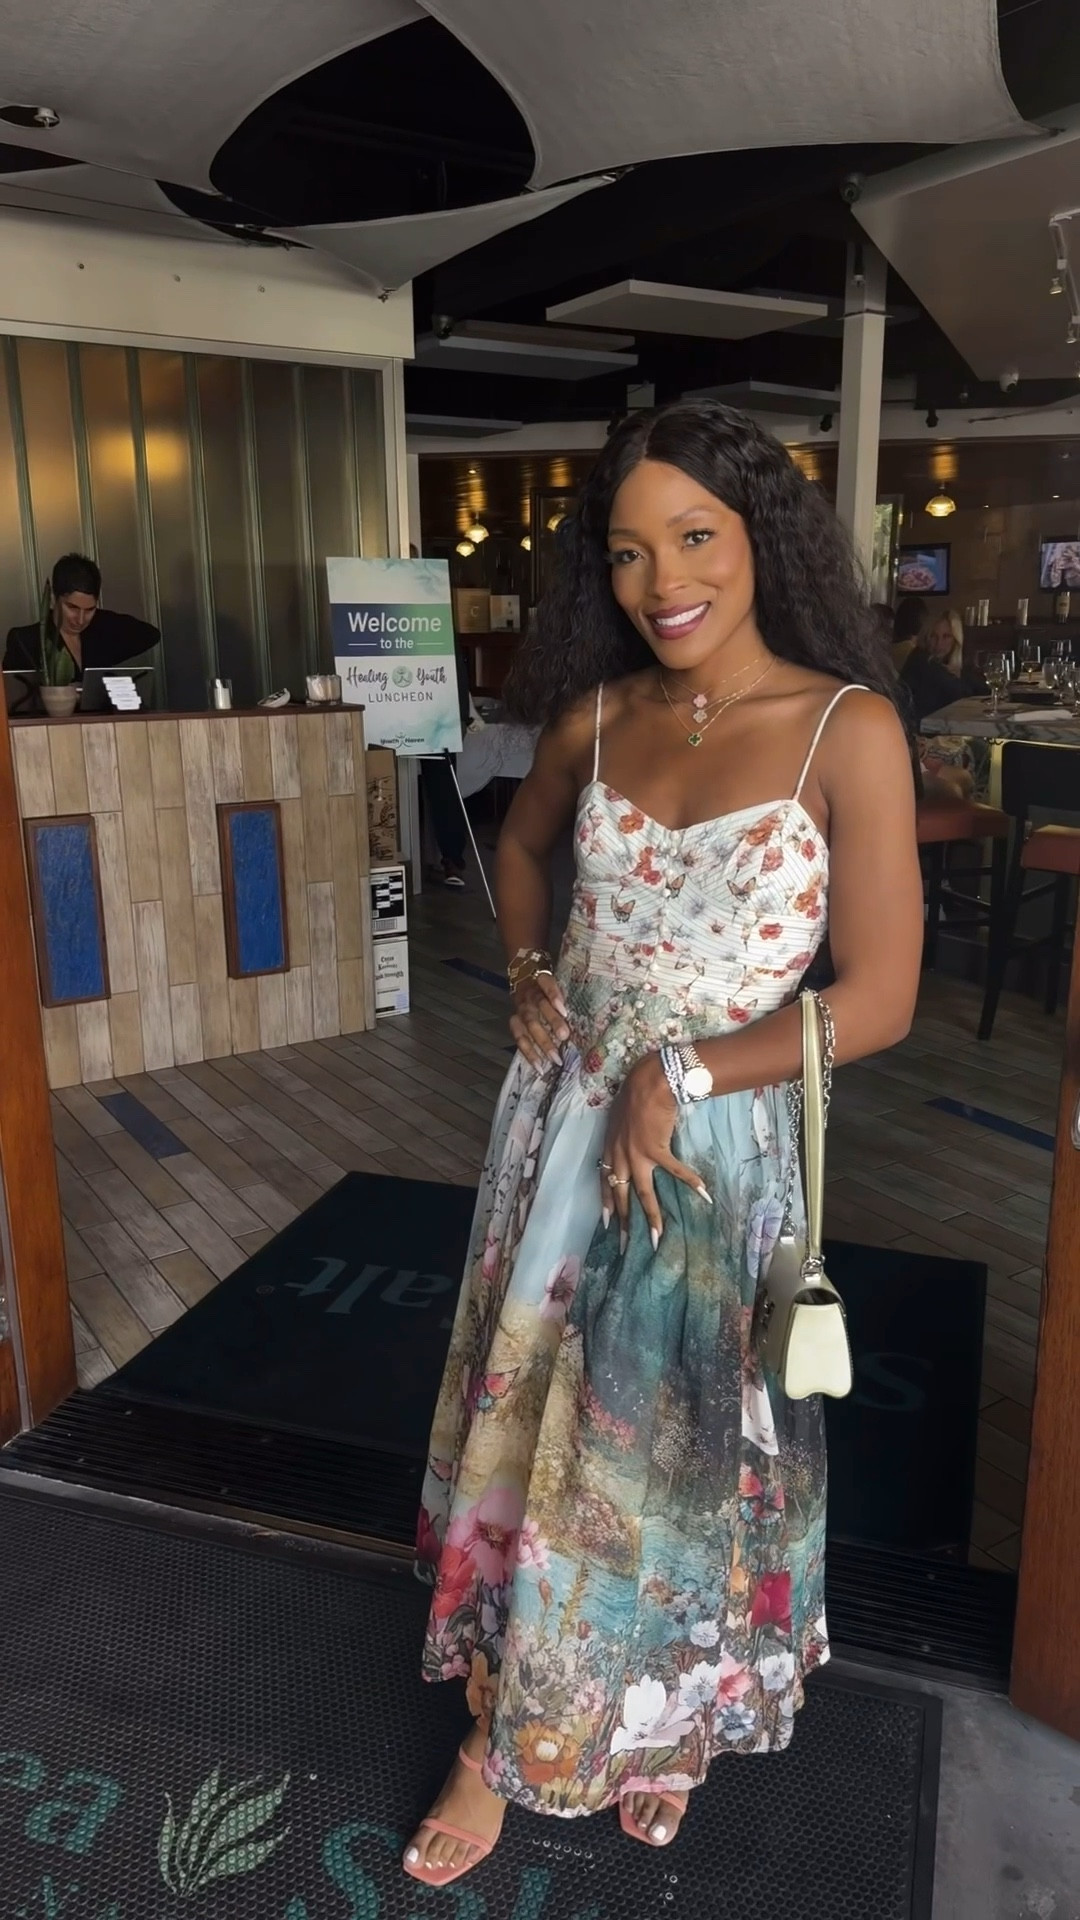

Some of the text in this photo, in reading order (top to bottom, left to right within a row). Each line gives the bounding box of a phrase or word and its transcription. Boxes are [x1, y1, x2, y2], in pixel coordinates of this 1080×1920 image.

[347, 612, 442, 633] Welcome
[380, 636, 414, 649] to the
[346, 666, 447, 691] Healing Youth
[368, 691, 433, 703] LUNCHEON
[284, 1256, 454, 1329] alt
